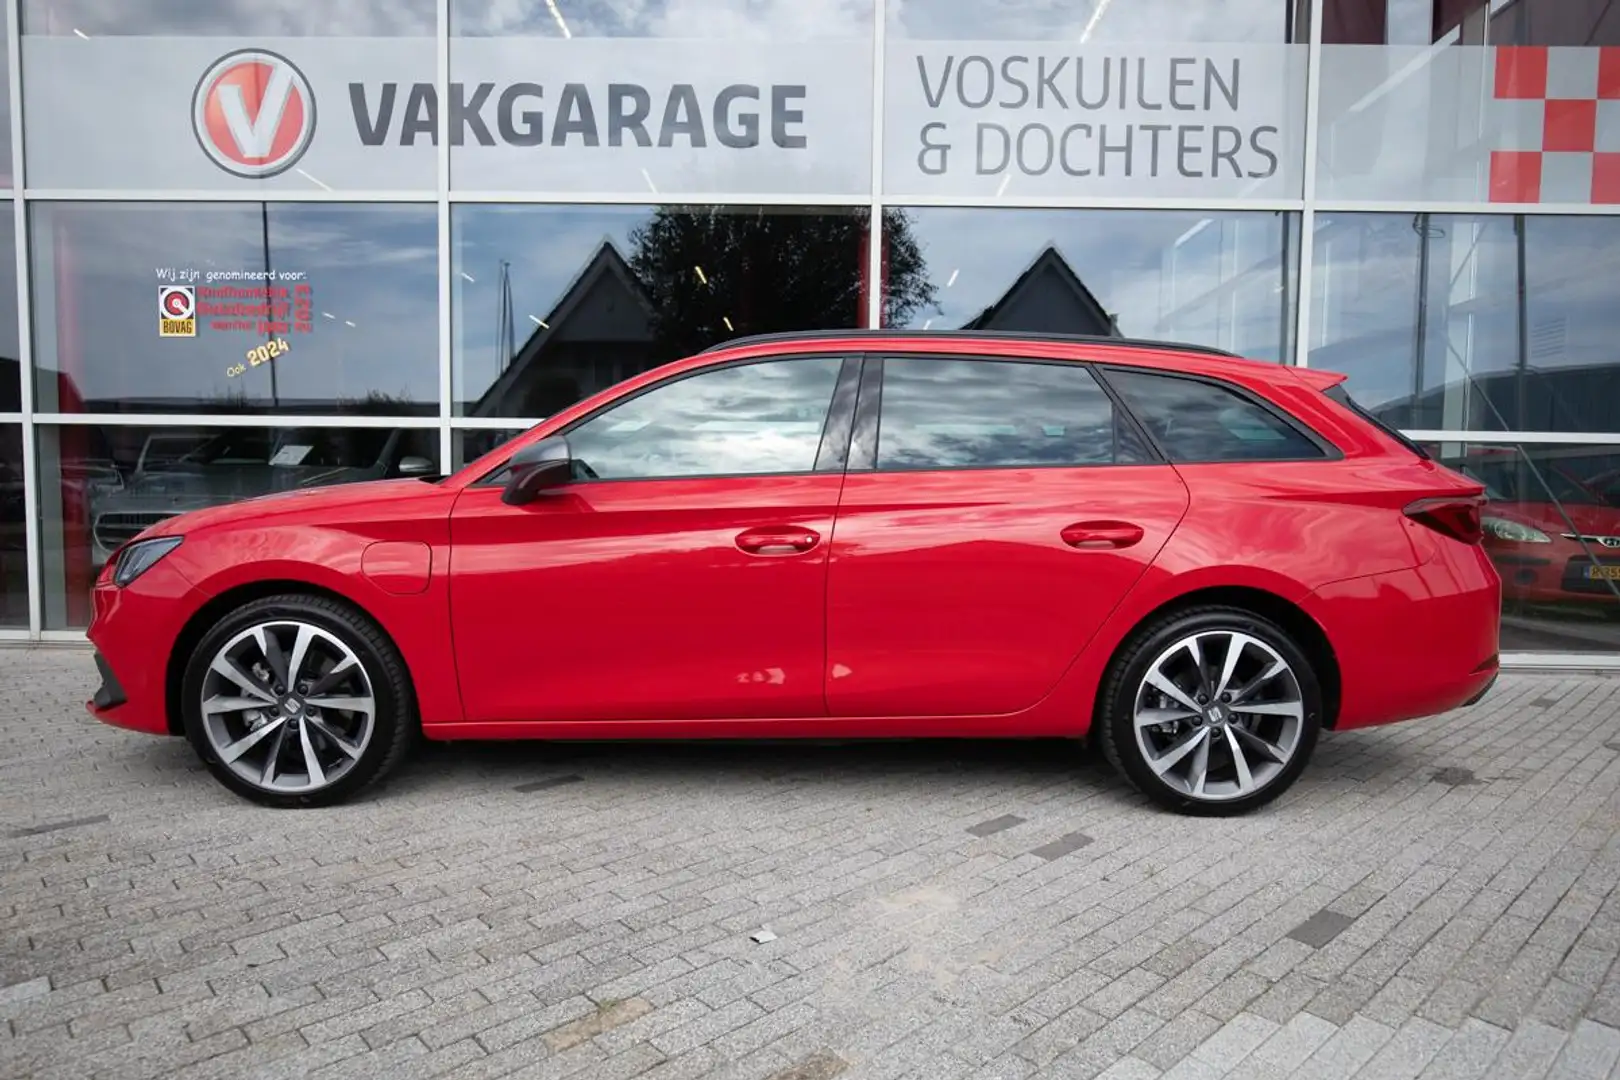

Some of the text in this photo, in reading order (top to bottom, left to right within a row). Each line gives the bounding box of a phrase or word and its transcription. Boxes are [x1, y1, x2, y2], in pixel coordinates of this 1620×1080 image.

[916, 55, 1240, 111] VOSKUILEN
[349, 82, 807, 148] VAKGARAGE
[917, 122, 1279, 178] & DOCHTERS
[155, 268, 308, 283] Wij zijn genomineerd voor:
[163, 320, 192, 334] BOVAG
[247, 337, 290, 367] 2024
